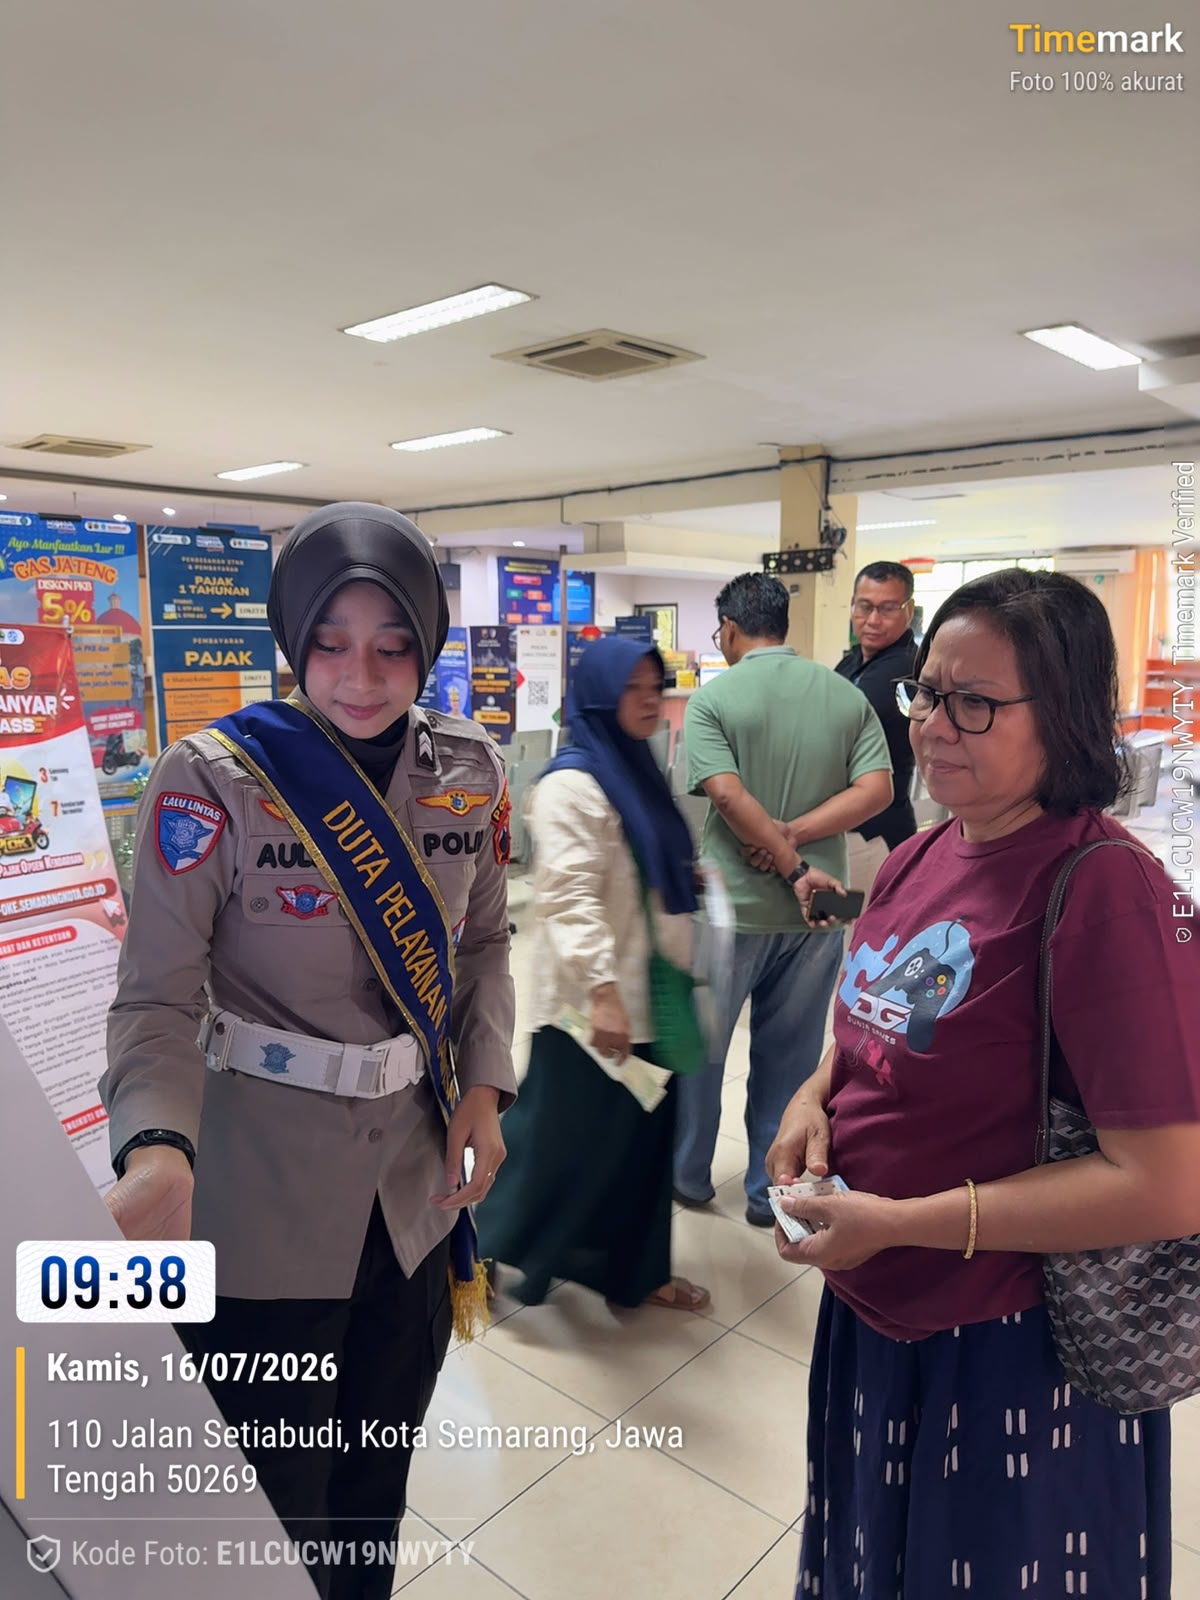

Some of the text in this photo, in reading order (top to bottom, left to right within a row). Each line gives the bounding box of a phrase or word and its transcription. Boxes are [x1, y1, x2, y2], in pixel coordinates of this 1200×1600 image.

[188, 584, 250, 597] TAHUNAN
[194, 574, 235, 587] PAJAK
[42, 591, 92, 623] 5%
[184, 650, 254, 667] PAJAK
[39, 767, 49, 784] 3
[162, 795, 222, 822] LALU LINTAS
[321, 800, 448, 1030] DUTA PELAYANAN
[850, 991, 911, 1030] DG
